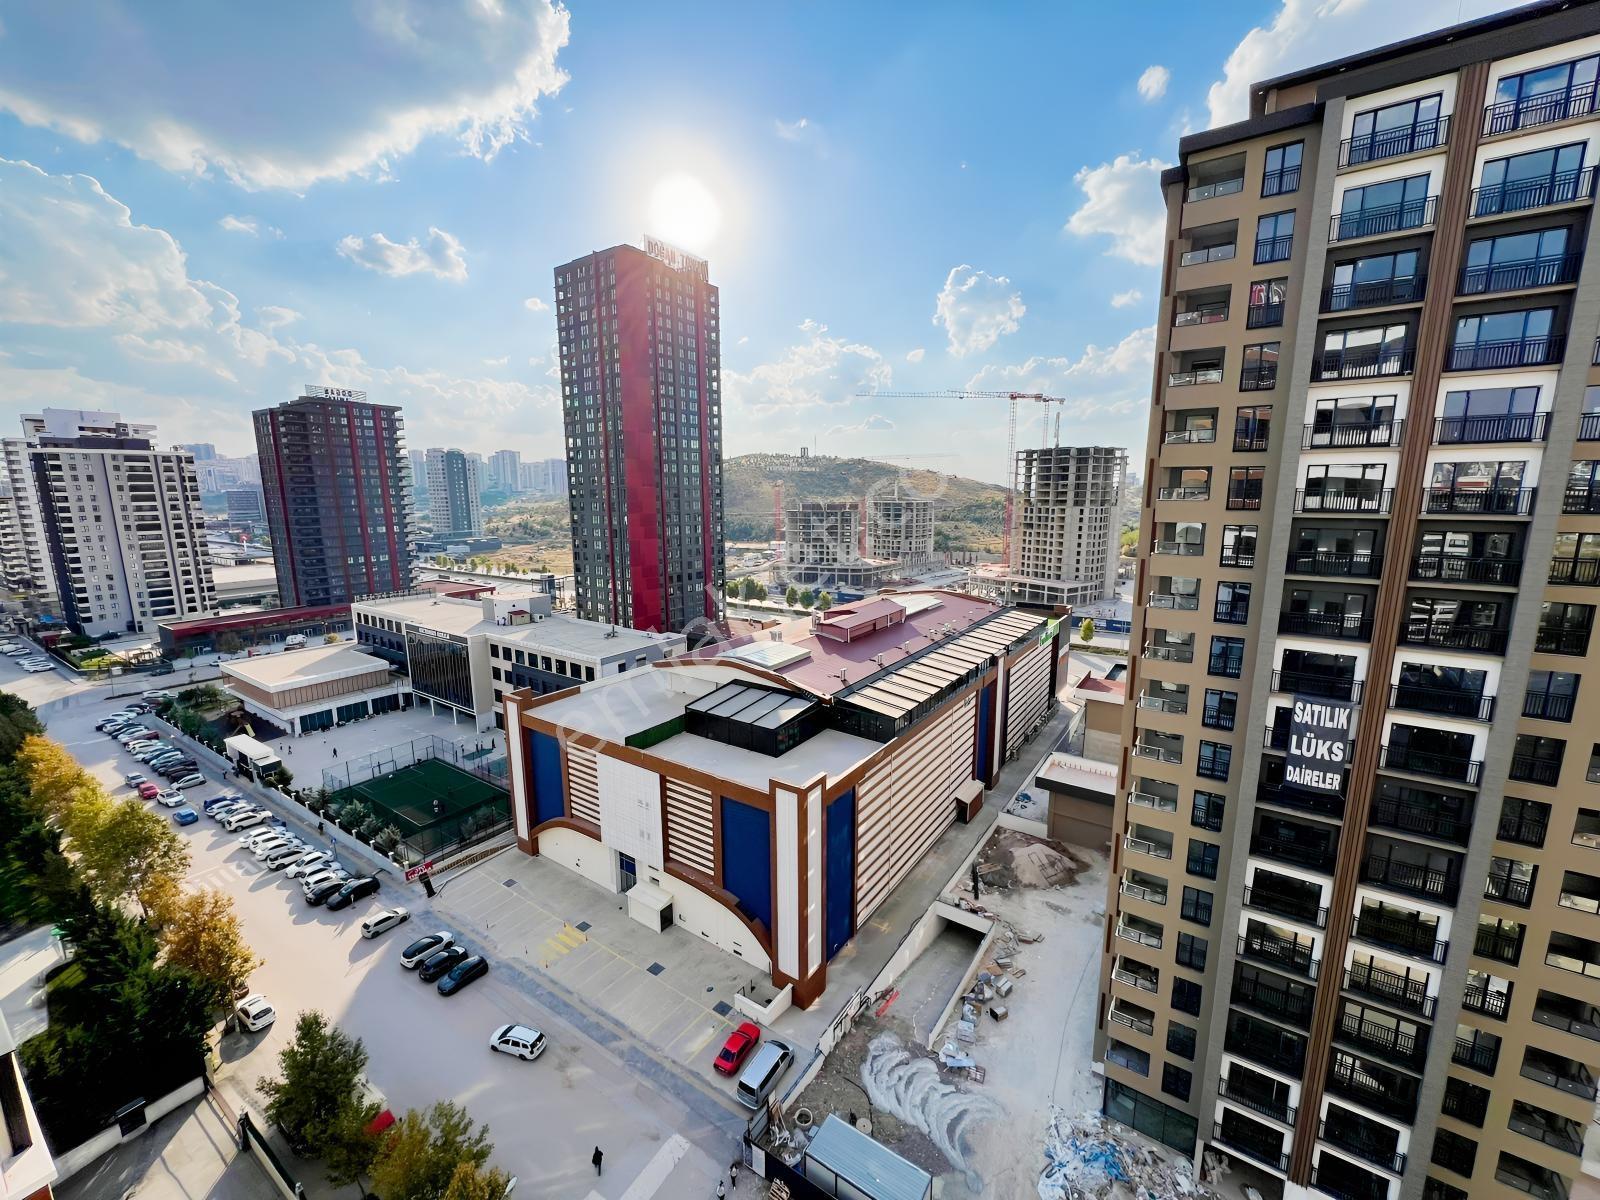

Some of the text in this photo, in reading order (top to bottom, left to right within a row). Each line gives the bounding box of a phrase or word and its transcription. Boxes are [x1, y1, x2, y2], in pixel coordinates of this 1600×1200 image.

[1294, 701, 1350, 729] SATILIK
[1290, 732, 1344, 762] LÜKS
[1286, 764, 1340, 790] DAİRELER
